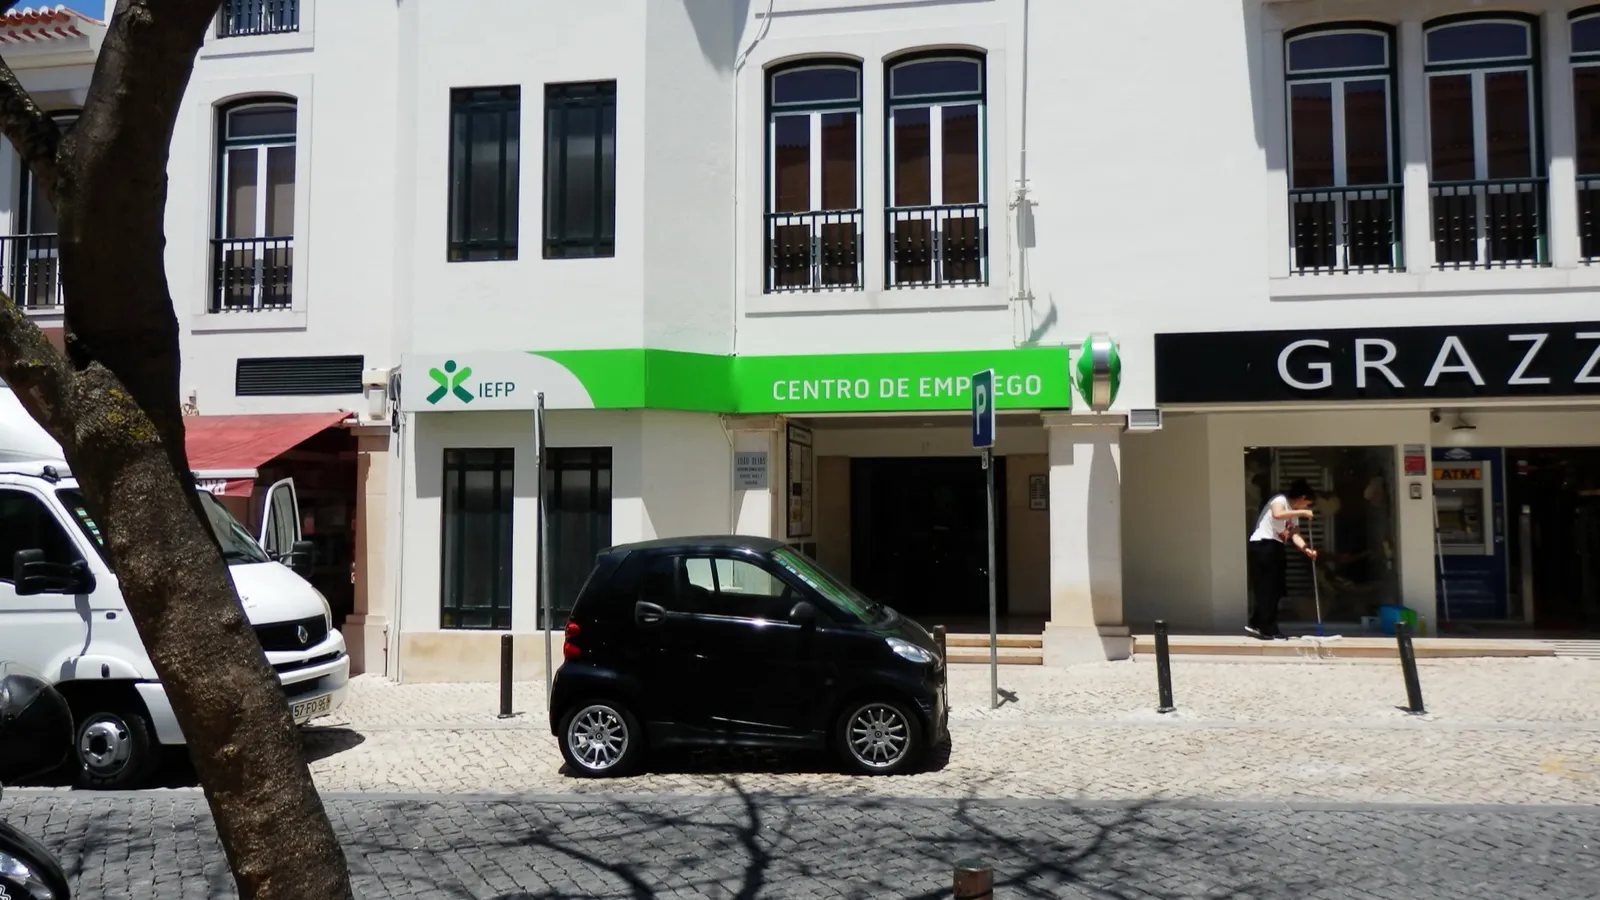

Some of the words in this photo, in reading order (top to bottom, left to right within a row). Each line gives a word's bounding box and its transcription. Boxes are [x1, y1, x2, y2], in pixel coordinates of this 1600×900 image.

[479, 382, 515, 398] IEFP
[773, 378, 869, 401] CENTRO
[880, 377, 910, 398] DE
[919, 374, 1042, 398] EMPEGO
[976, 384, 986, 435] P
[1441, 469, 1475, 480] ATM
